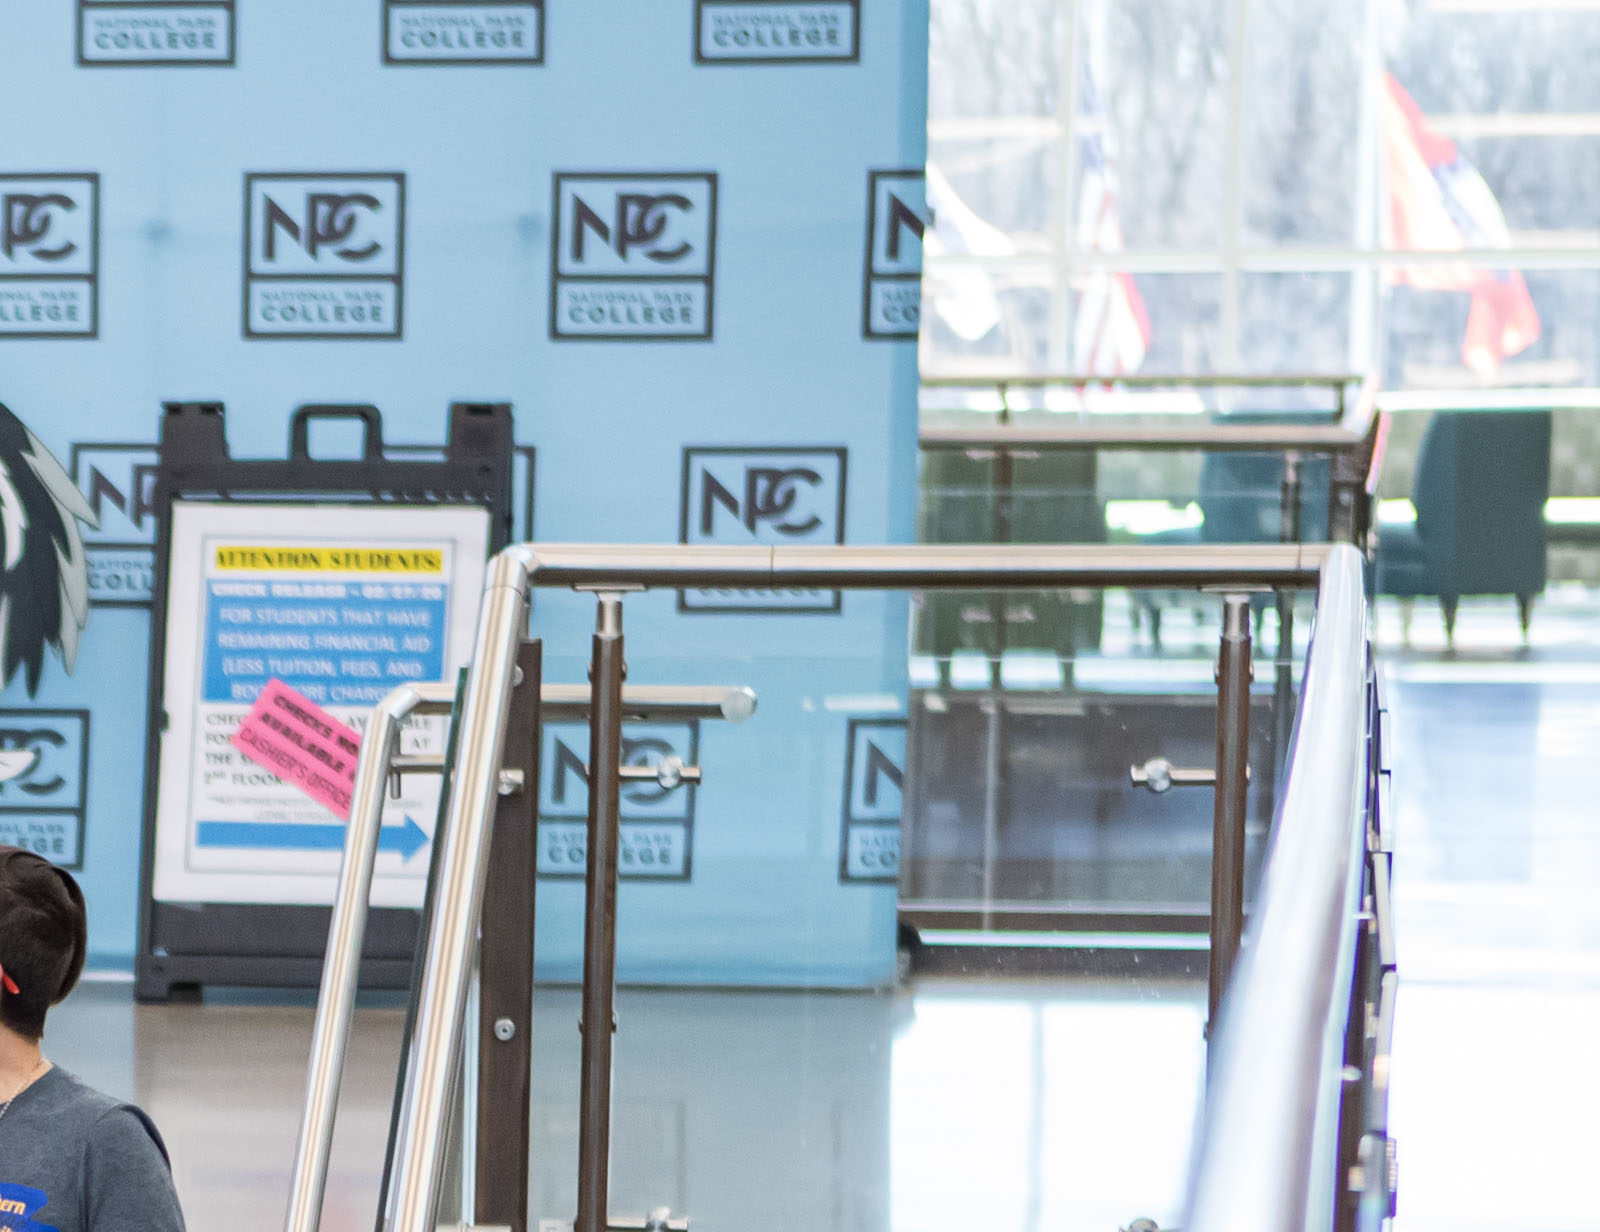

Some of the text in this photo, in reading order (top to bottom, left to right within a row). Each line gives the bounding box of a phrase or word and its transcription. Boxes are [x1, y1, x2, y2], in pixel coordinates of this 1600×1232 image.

[95, 31, 216, 49] COLLEGE
[401, 31, 525, 48] COLLEGE
[713, 29, 839, 47] COLLEGE
[263, 193, 382, 263] NPC
[572, 193, 694, 263] NPC
[261, 305, 382, 322] COLLEGE
[569, 306, 693, 324] COLLEGE
[701, 466, 823, 538] NPC
[217, 551, 321, 568] ATTENTION
[220, 607, 431, 627] FOR STUDENTS THAT HAVE
[218, 632, 431, 652] REMAINING FINANCIAL AID
[386, 660, 424, 677] AND
[273, 694, 334, 739] CHECKS
